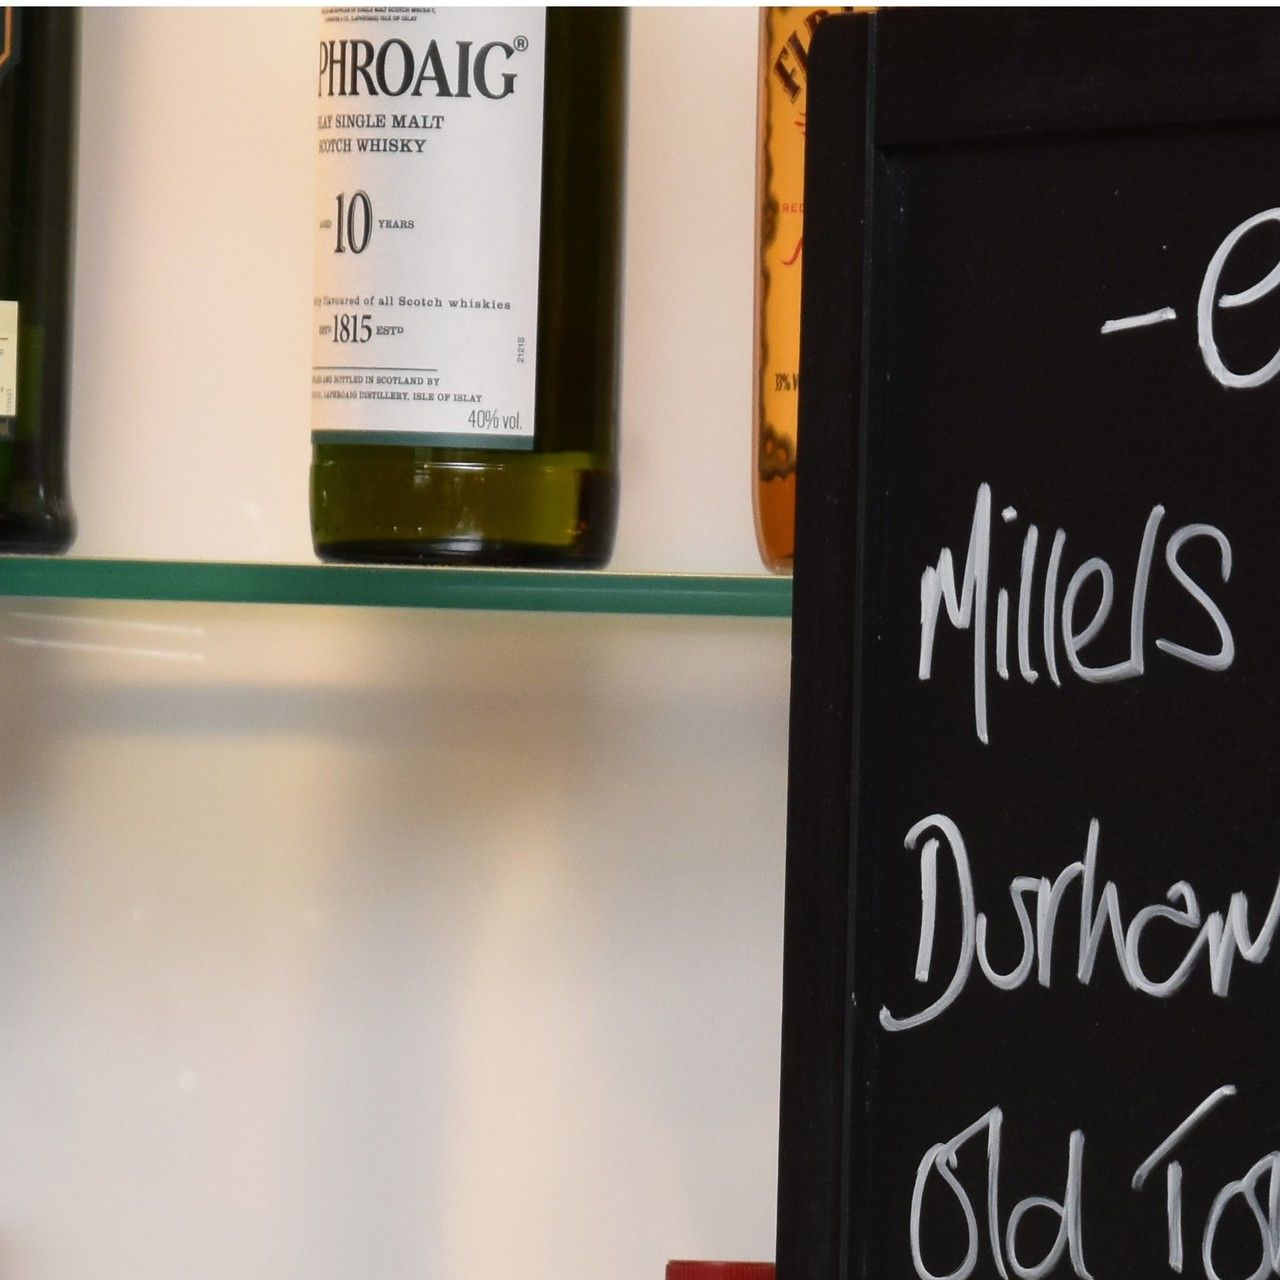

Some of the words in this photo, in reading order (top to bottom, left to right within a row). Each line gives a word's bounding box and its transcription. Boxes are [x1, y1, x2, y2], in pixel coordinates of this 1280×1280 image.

[335, 114, 386, 129] SINGLE
[391, 115, 445, 130] MALT
[357, 138, 427, 153] WHISKY
[334, 189, 373, 254] 10
[378, 219, 415, 229] YEARS
[364, 296, 375, 306] of
[378, 296, 393, 306] all
[398, 296, 443, 308] Scotch
[448, 298, 512, 310] whiskies
[333, 313, 372, 343] 1815
[376, 376, 424, 386] SCOTLAND
[427, 377, 440, 386] BY
[412, 391, 434, 401] ISLE
[437, 392, 451, 402] OF
[453, 392, 482, 403] ISLAY
[468, 409, 499, 430] 40%
